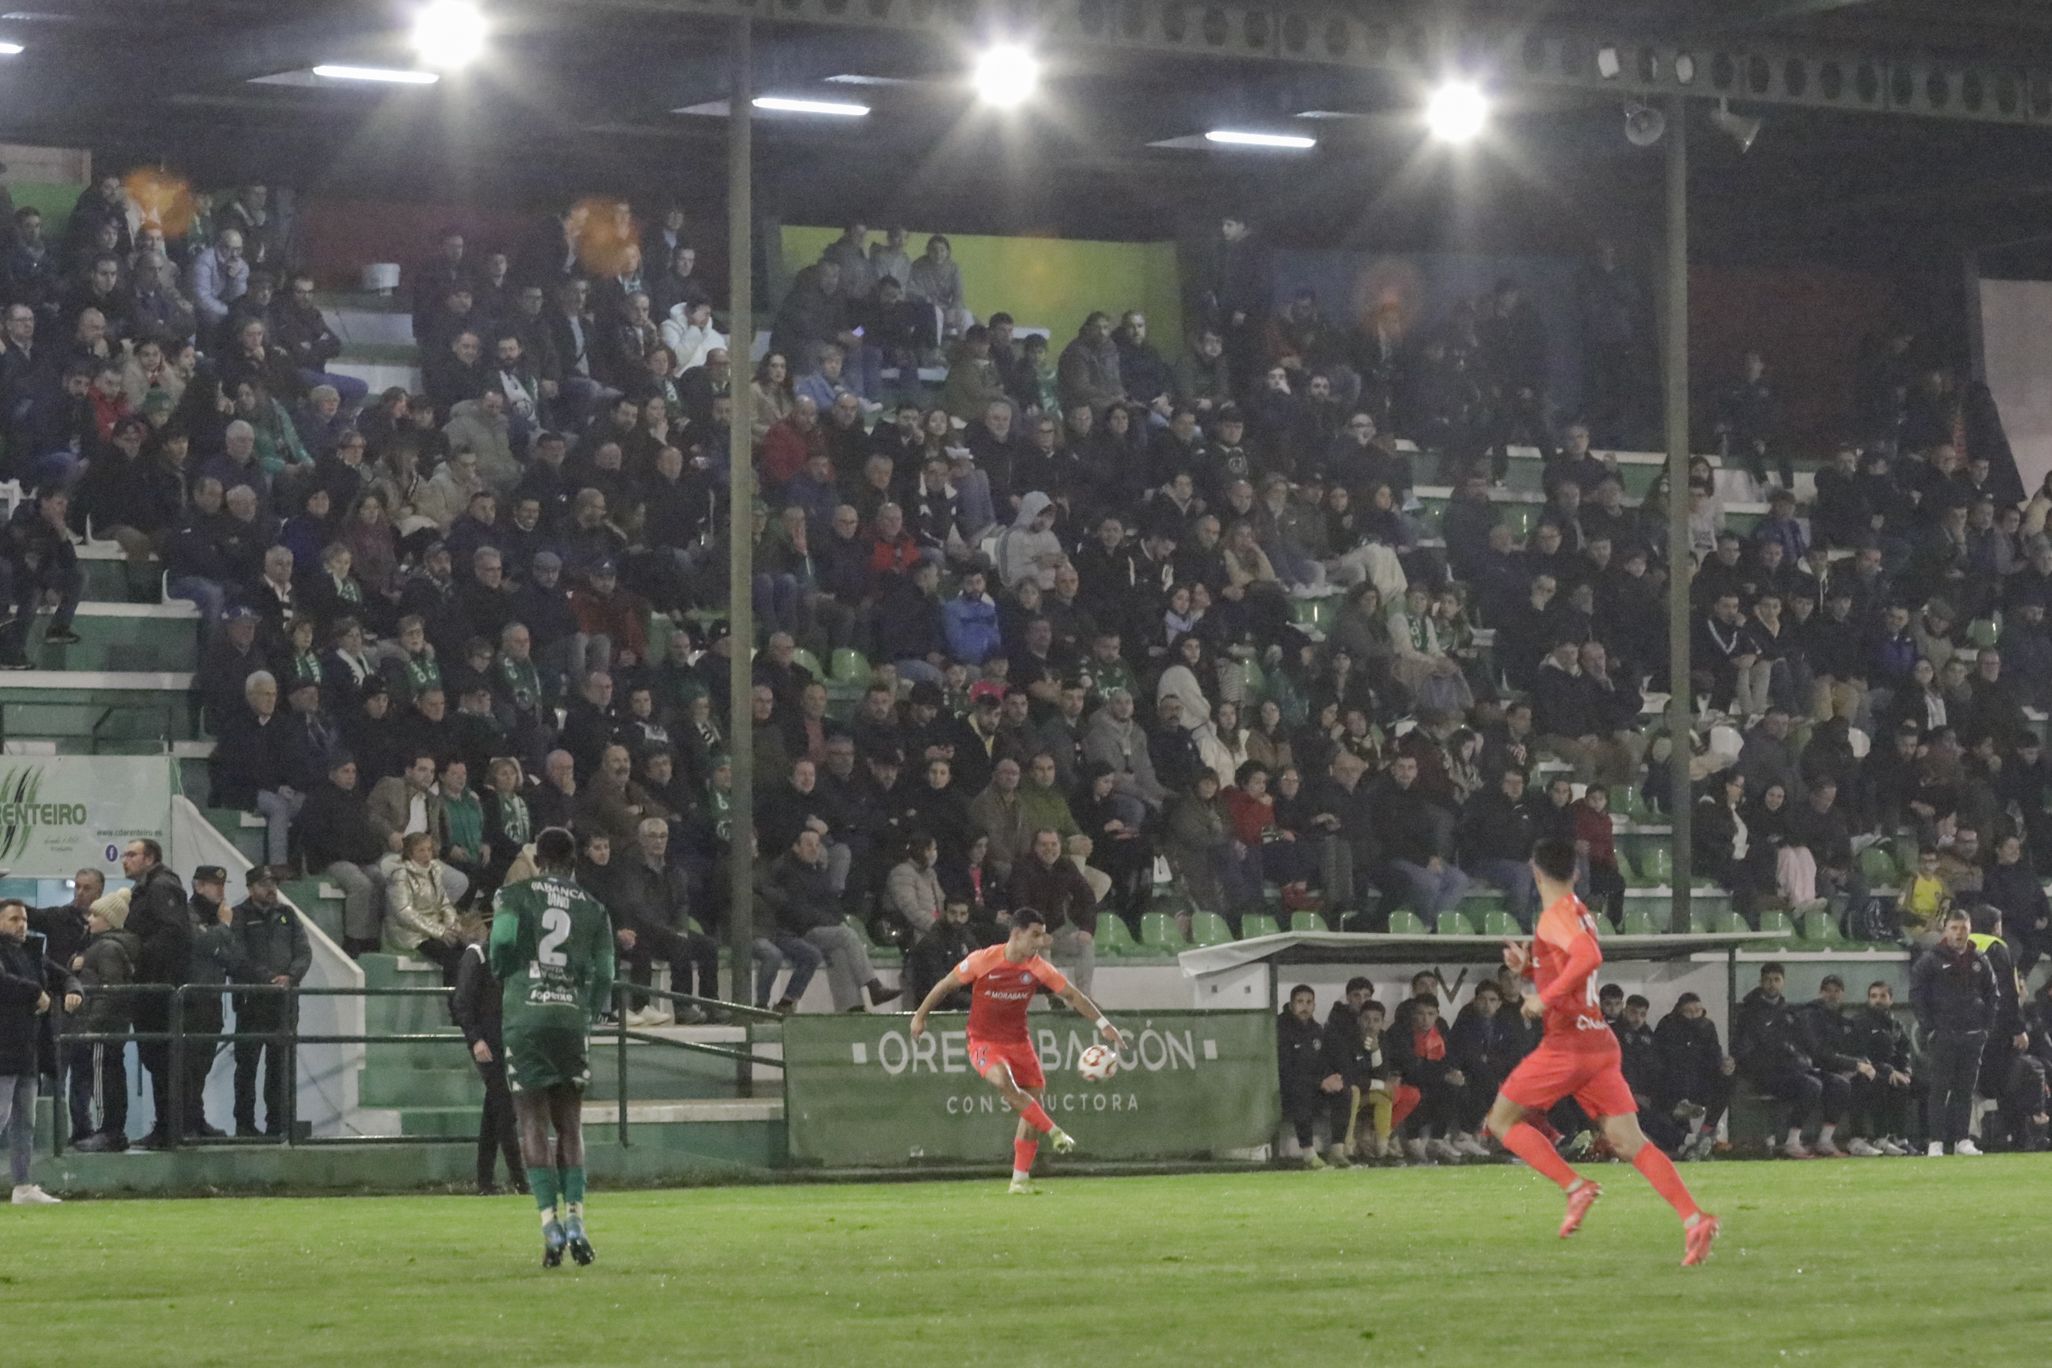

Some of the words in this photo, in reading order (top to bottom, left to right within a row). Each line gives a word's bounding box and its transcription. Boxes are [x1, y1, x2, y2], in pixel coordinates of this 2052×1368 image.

[0, 803, 87, 825] ENTEIRO
[538, 907, 571, 968] 2
[946, 1093, 1139, 1115] CONSUCTORA
